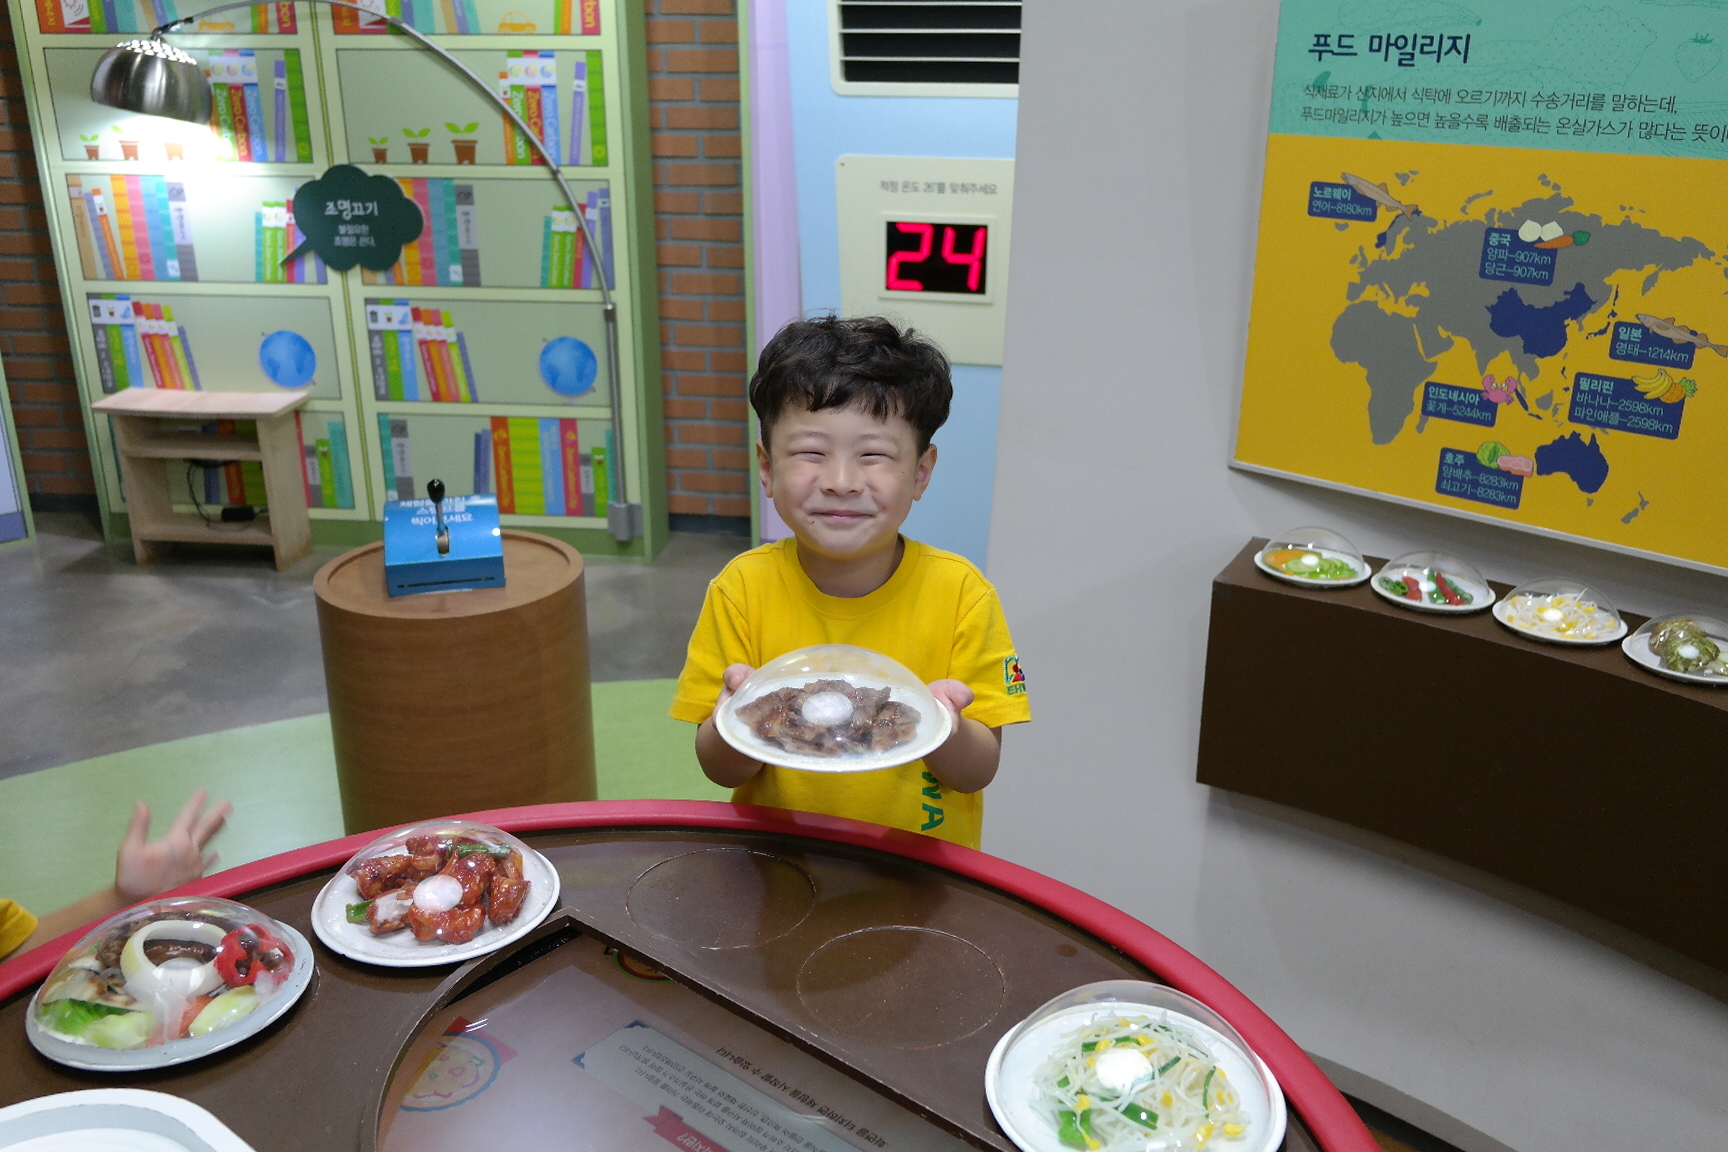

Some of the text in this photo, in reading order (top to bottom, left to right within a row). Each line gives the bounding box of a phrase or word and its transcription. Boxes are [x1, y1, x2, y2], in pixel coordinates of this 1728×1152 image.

[1308, 33, 1471, 67] 푸드 마일리지
[1303, 84, 1678, 114] 식재료가 산지에서 식탁에 오르기까지 수송거리를 말하는데,
[1300, 106, 1728, 143] 푸드마일리지가 높으면 높을수록 배출되는 온실가스가 많다는 뜻이
[1313, 187, 1351, 200] 노르웨이
[324, 200, 379, 220] 조명끄기
[1489, 232, 1512, 247] 중국
[886, 222, 987, 291] 24
[1487, 247, 1551, 265] 양파-907km
[1485, 262, 1549, 279] 당근-907km
[1618, 326, 1643, 341] 일본
[1579, 376, 1614, 395] 필리핀
[1428, 386, 1480, 406] 인도네시아
[1444, 452, 1465, 466] 호주
[1007, 683, 1026, 695] EH
[715, 1047, 751, 1070] 있습니다
[751, 1067, 762, 1076] 수
[760, 1073, 790, 1092] 시작할
[817, 1105, 856, 1130] 터치하면
[856, 1127, 888, 1148] 화면을
